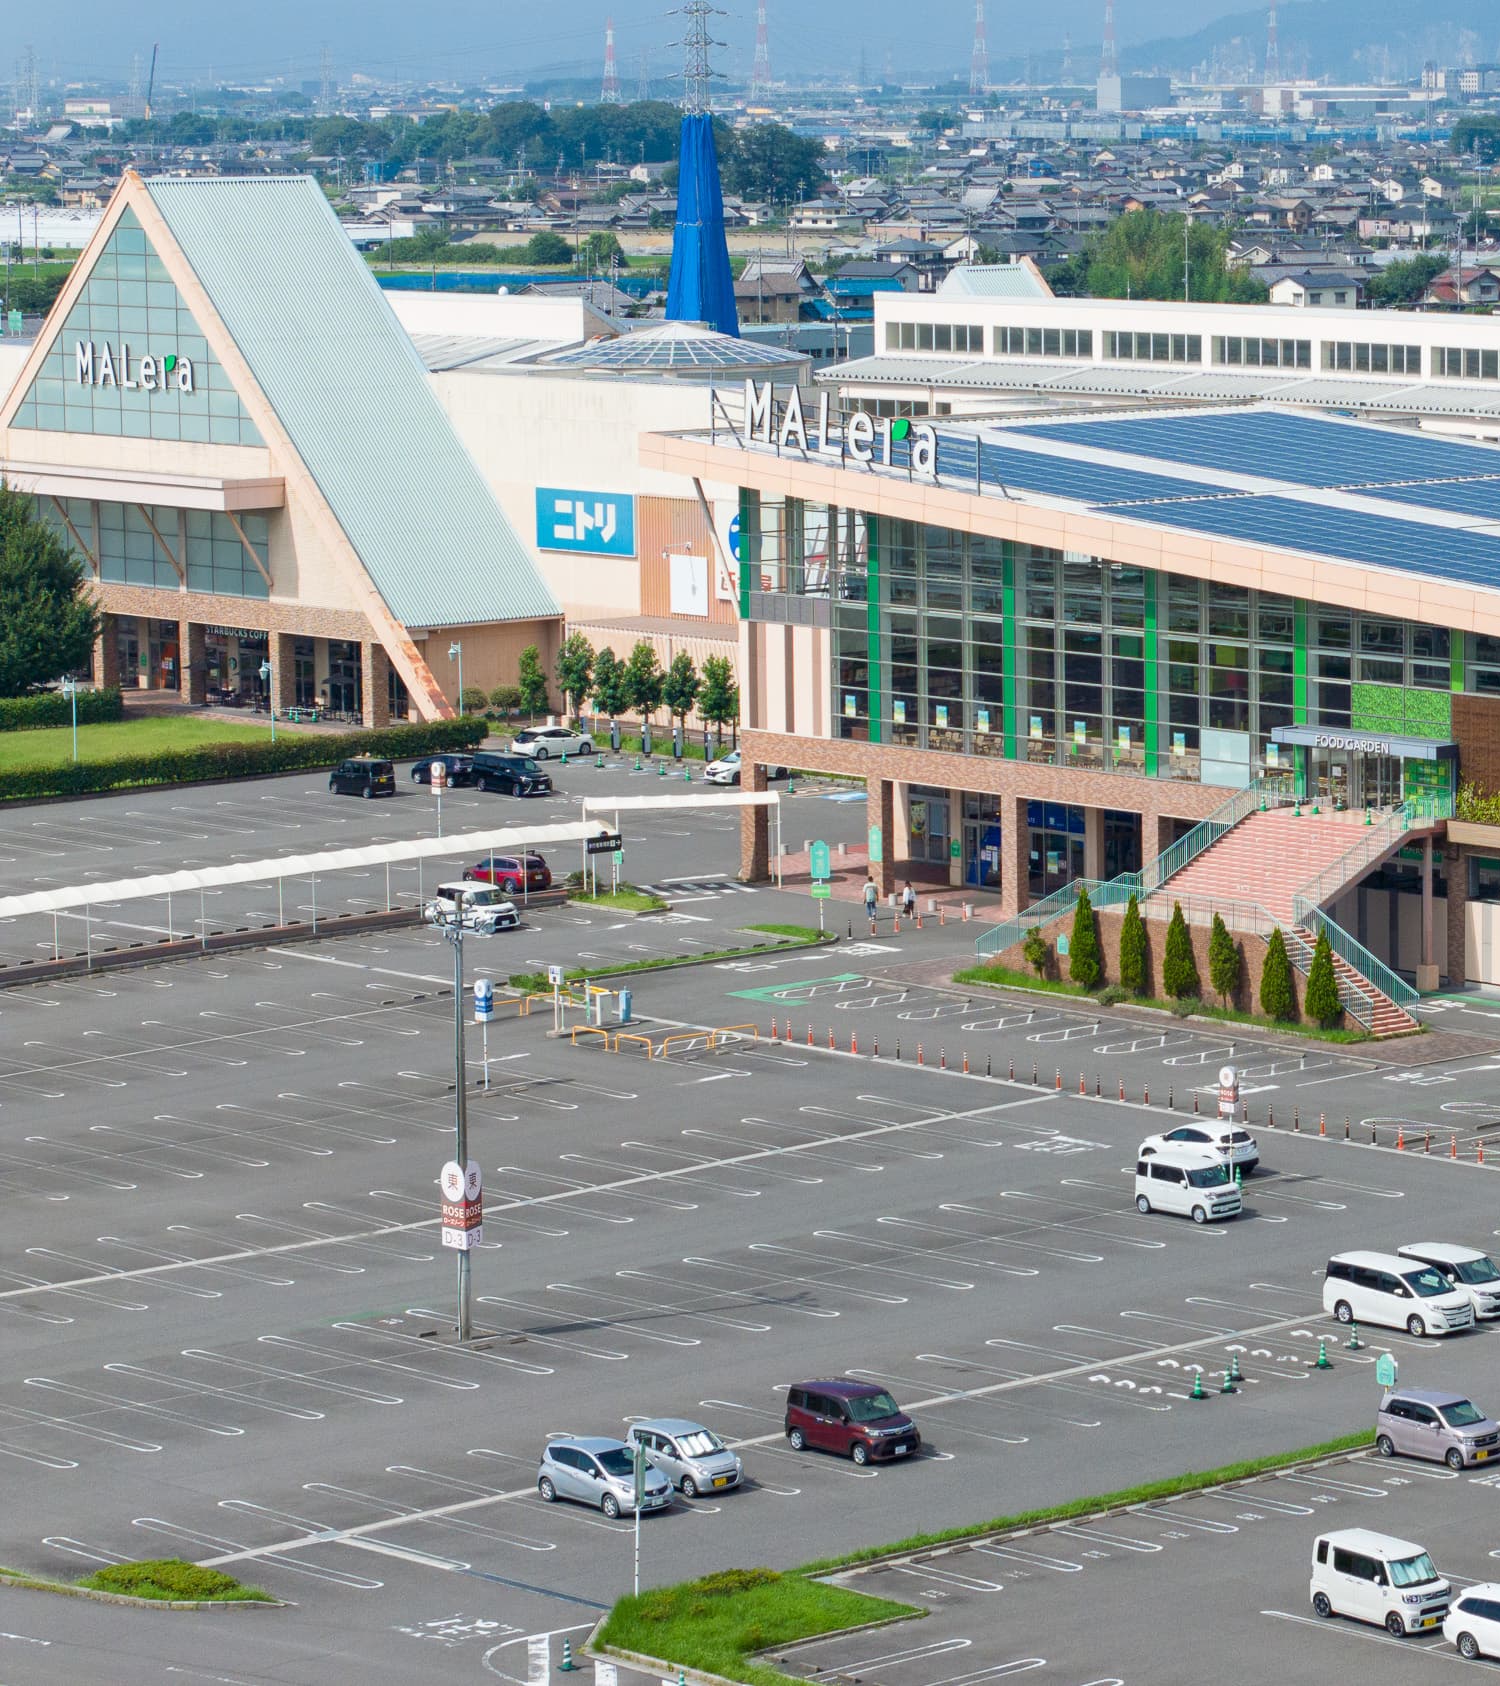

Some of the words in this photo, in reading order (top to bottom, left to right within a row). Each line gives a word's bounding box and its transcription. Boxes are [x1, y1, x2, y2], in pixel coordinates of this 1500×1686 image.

[76, 341, 194, 393] MALera
[744, 378, 939, 476] MALera
[553, 499, 616, 544] ニトリ
[205, 625, 248, 639] STARBUCKS
[248, 629, 268, 640] COFF
[1314, 735, 1345, 750] FOOD
[1345, 739, 1389, 754] GARDEN
[447, 1172, 459, 1191] 東
[442, 1205, 465, 1219] ROSE
[466, 1203, 481, 1218] ROSE
[445, 1231, 463, 1247] D-3
[467, 1229, 481, 1247] D-3
